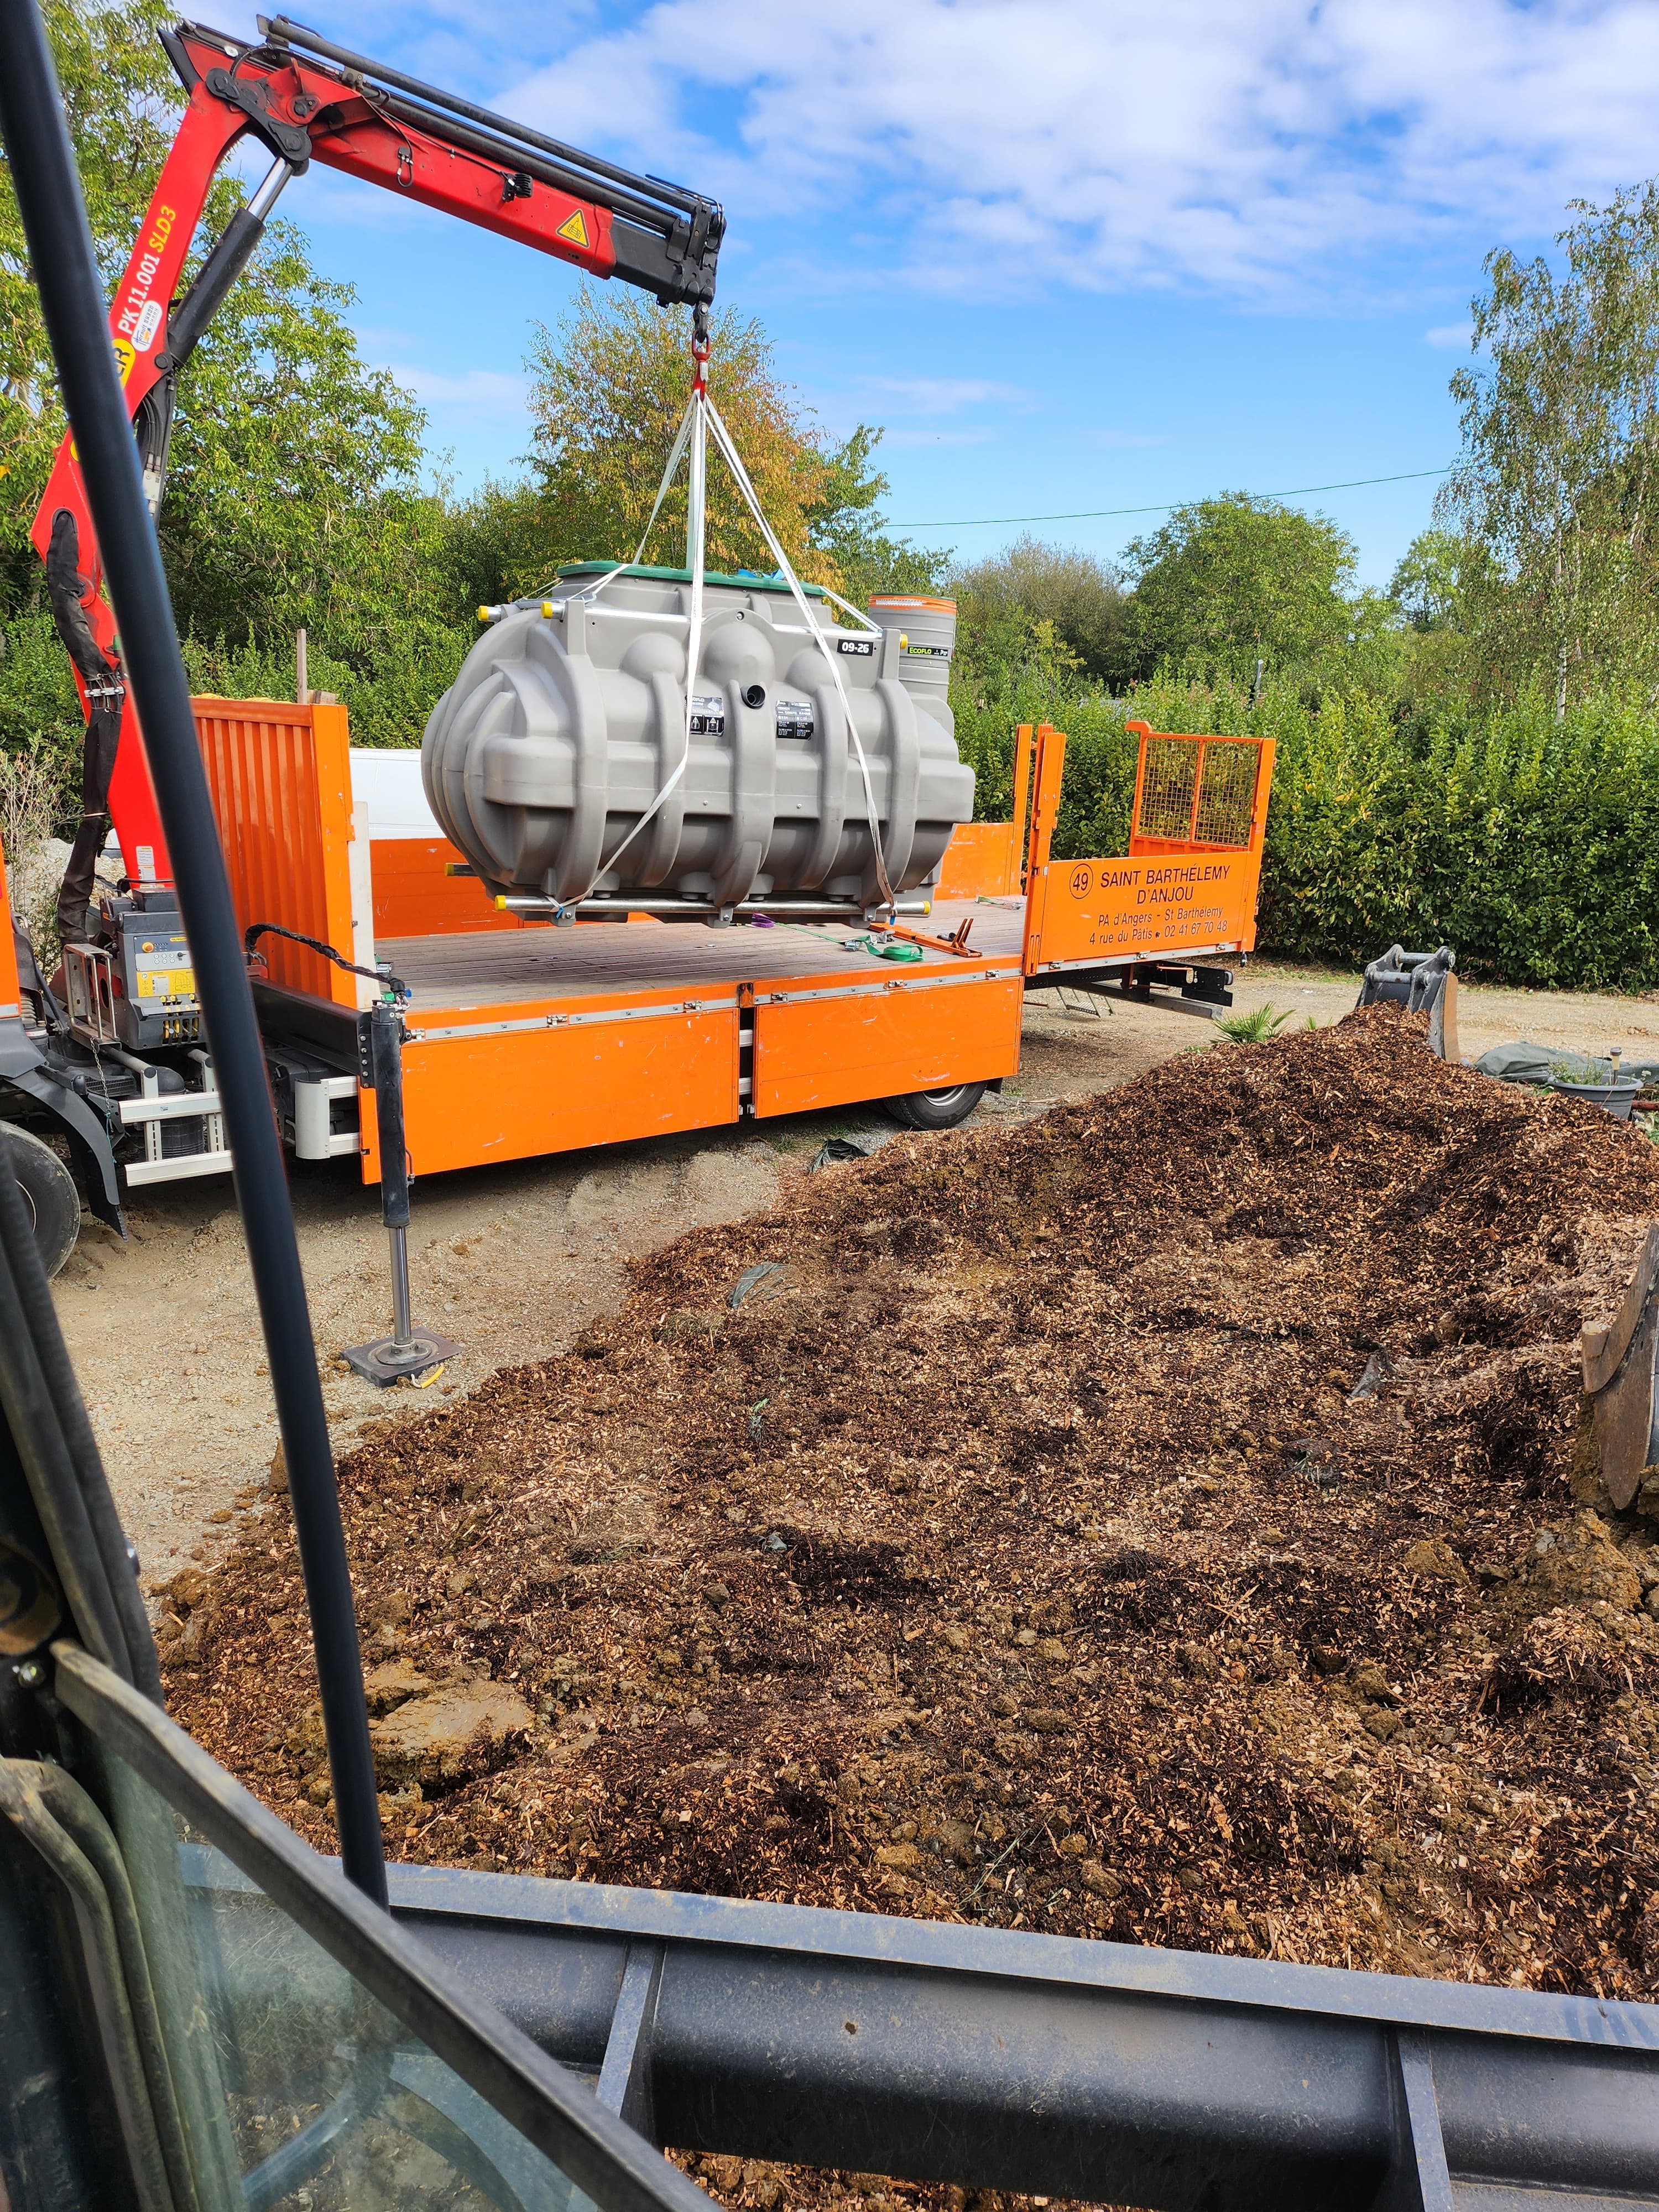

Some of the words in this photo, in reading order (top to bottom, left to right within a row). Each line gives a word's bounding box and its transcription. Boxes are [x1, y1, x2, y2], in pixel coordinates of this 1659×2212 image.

[118, 307, 139, 335] PK
[842, 641, 869, 654] 09-26
[1073, 872, 1088, 891] 49
[1100, 870, 1141, 888] SAINT
[1146, 863, 1230, 885] BARTHÉLEMY
[1137, 886, 1193, 904] D'ANJOU
[1098, 914, 1109, 927] PA
[1114, 912, 1152, 926] d'Angers
[1165, 909, 1173, 921] St
[1177, 906, 1223, 920] Barthélemy
[1089, 932, 1095, 945] 4
[1099, 933, 1114, 943] rue
[1118, 930, 1129, 942] du
[1132, 927, 1152, 940] Pâtis
[1164, 925, 1176, 937] 02
[1178, 924, 1188, 936] 41
[1191, 923, 1202, 934] 67
[1204, 921, 1214, 933] 70
[1217, 920, 1228, 932] 48
